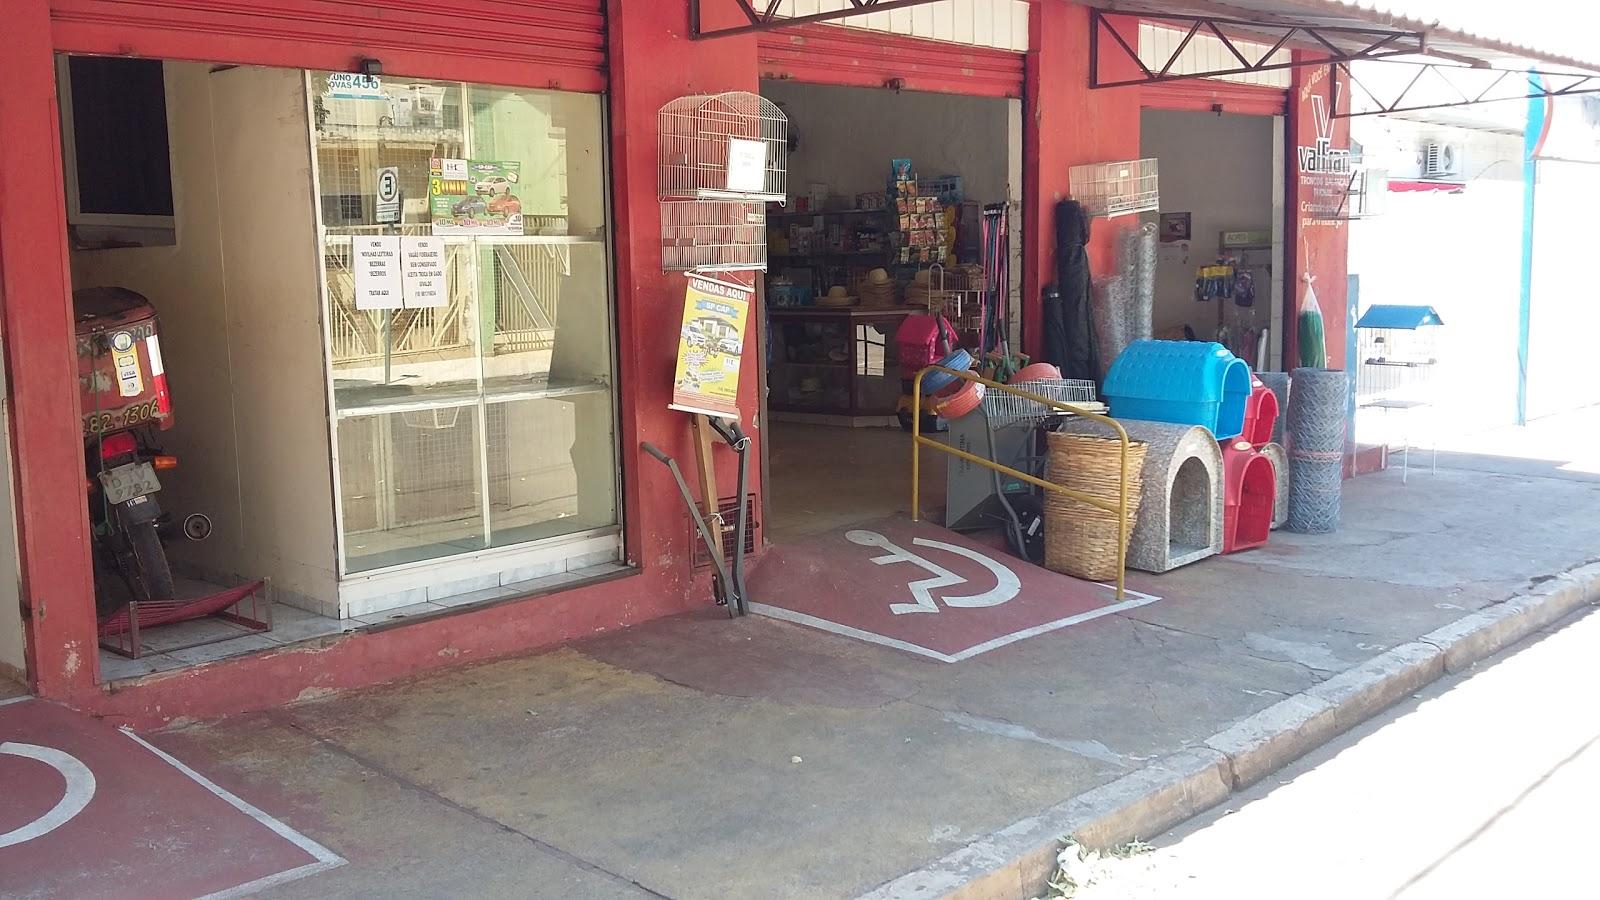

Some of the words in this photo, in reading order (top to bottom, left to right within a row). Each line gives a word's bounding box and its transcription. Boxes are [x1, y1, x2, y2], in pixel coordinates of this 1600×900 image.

[692, 278, 725, 295] VENDAS
[726, 287, 747, 300] AQUI
[706, 303, 715, 311] SP
[716, 305, 730, 314] CAP
